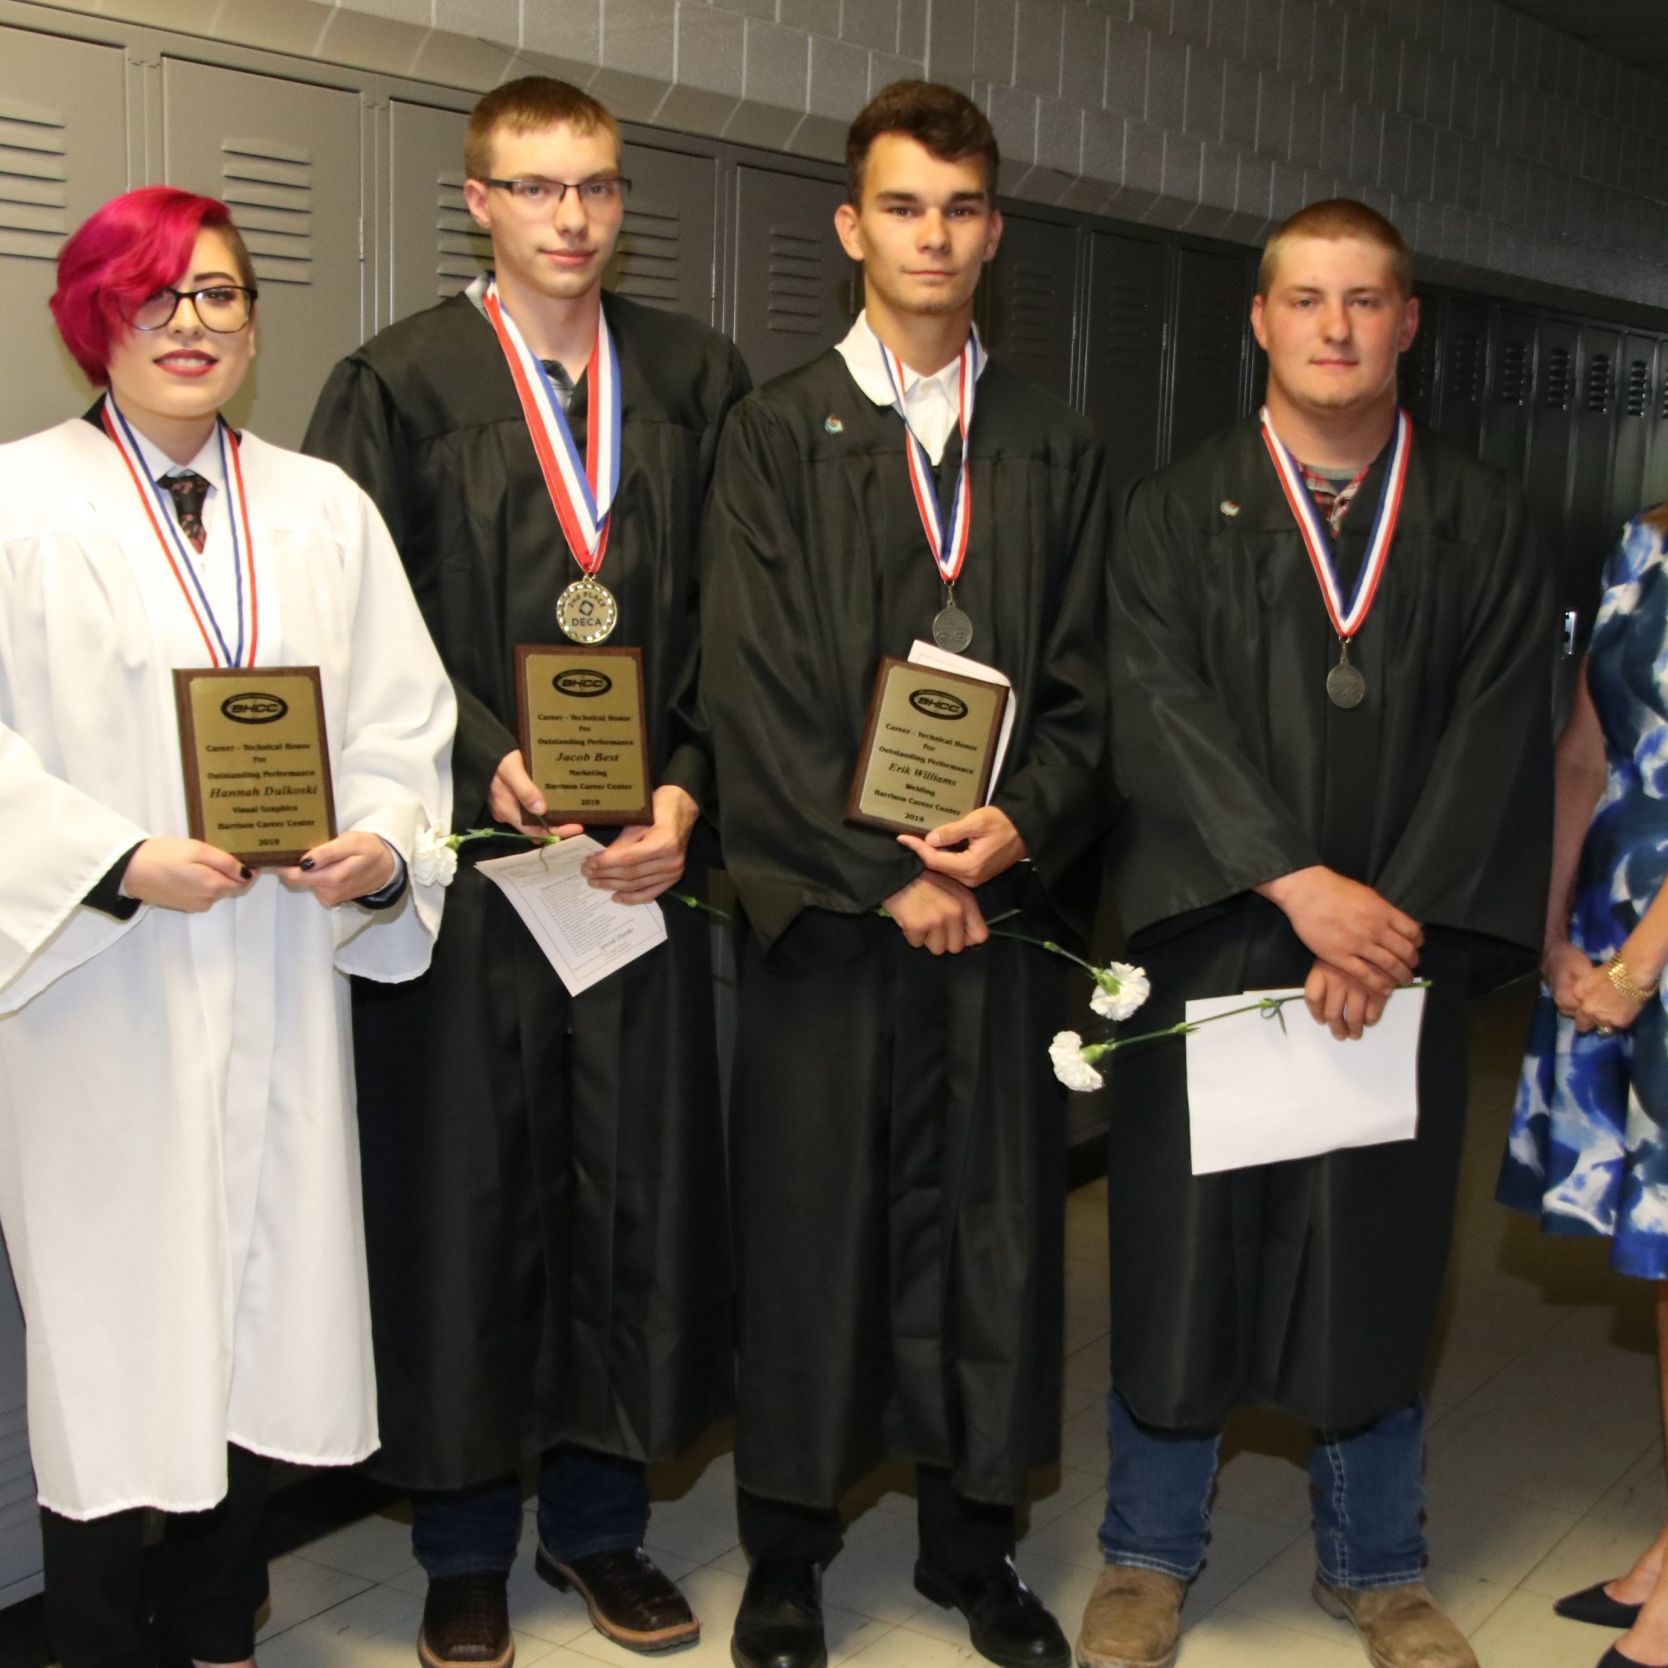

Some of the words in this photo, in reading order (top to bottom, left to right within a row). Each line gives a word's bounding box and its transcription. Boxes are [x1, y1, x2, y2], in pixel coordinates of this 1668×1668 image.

[583, 591, 606, 608] PLACE
[571, 617, 602, 627] DECA
[561, 678, 604, 688] BHCC
[231, 703, 278, 713] BHCC
[917, 696, 960, 713] BHCC
[537, 713, 563, 721] Career
[570, 713, 606, 721] Technical
[885, 722, 911, 735] Career
[918, 730, 953, 746] Technical
[954, 740, 978, 752] Honor
[206, 744, 235, 752] Career
[243, 743, 282, 751] Technical
[537, 738, 585, 747] Outstanding
[587, 738, 634, 746] Performance
[922, 743, 935, 752] For
[555, 752, 590, 762] Jacob
[594, 752, 619, 762] Best
[879, 745, 926, 764] Outstanding
[927, 757, 974, 775] Performance
[207, 772, 261, 780] Outstanding
[568, 768, 608, 778] Marketing
[888, 762, 911, 776] Erik
[914, 768, 957, 786] Williams
[544, 782, 578, 790] Harrison
[579, 782, 605, 790] Career
[607, 782, 633, 790] Center
[905, 783, 936, 797] Welding
[210, 787, 260, 798] Hannah
[873, 788, 907, 802] Harrison
[908, 797, 934, 809] Career
[935, 803, 961, 816] Center
[232, 805, 258, 814] Visual
[260, 804, 298, 814] Graphics
[904, 812, 925, 823] 2019
[217, 822, 254, 830] Harrison
[256, 820, 285, 829] Career
[286, 819, 315, 828] Center
[258, 838, 280, 847] 2019
